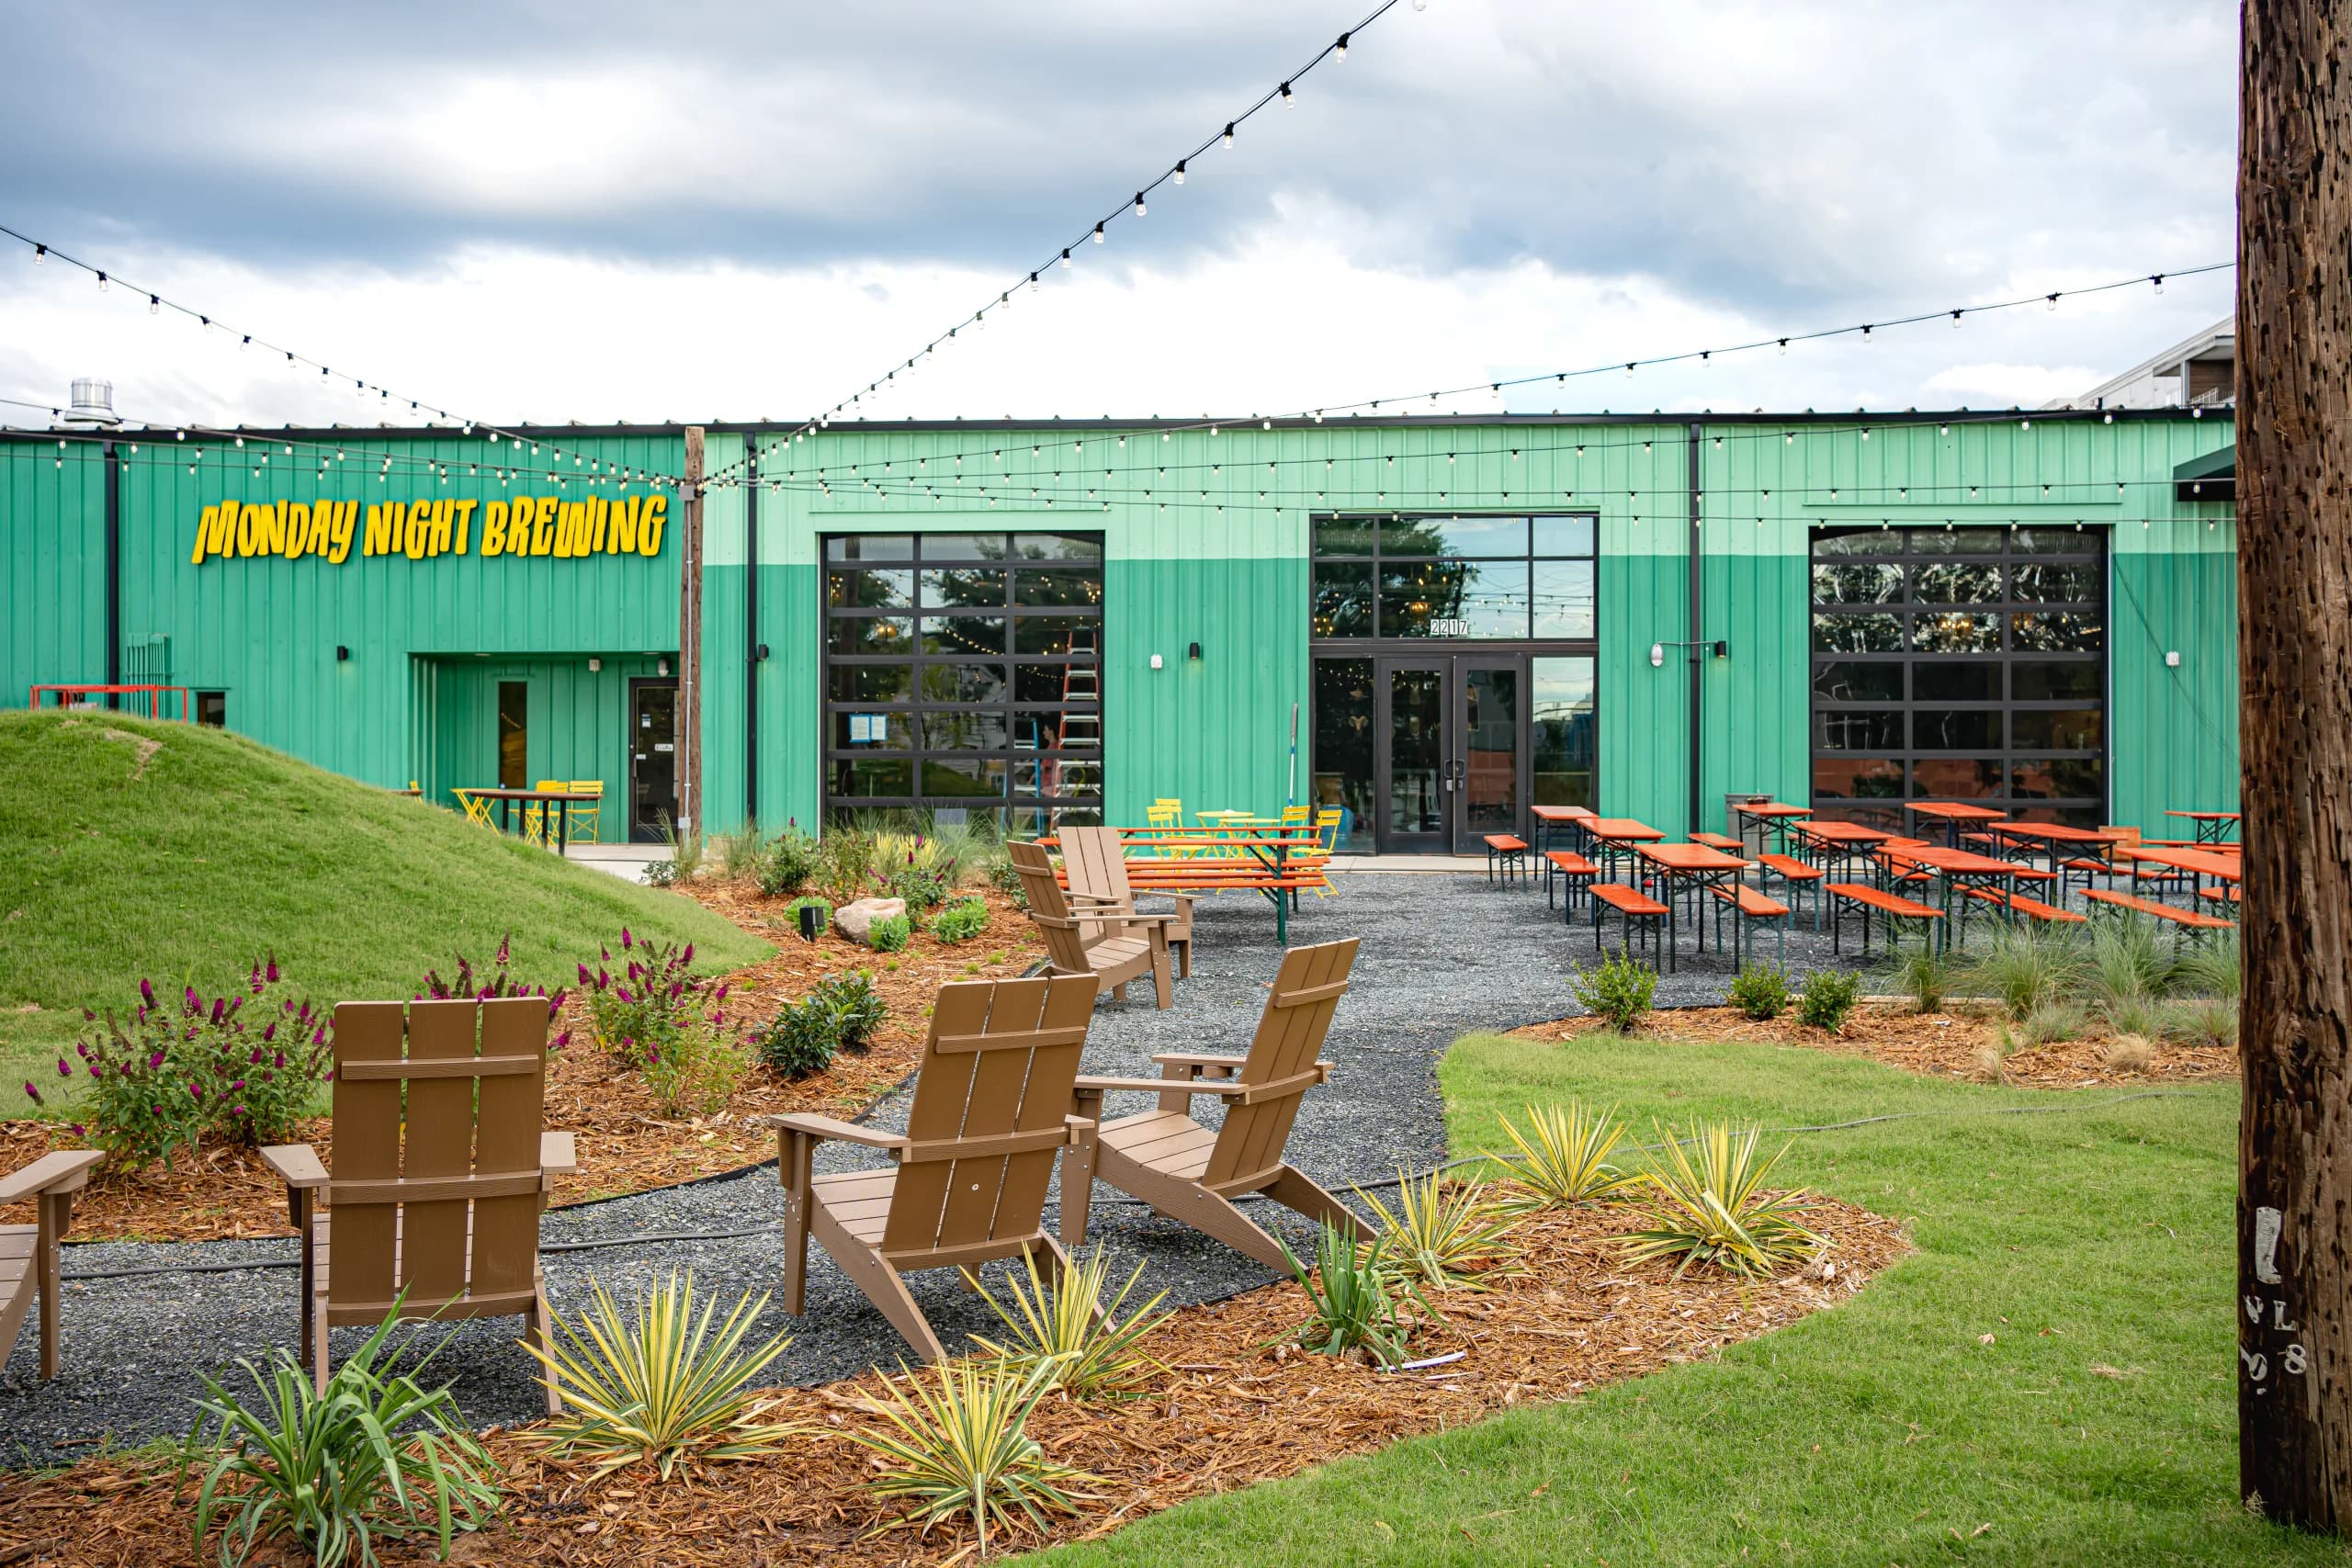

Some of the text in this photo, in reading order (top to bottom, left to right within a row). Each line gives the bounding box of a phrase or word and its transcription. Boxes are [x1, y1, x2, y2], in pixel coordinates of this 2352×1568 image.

[191, 494, 667, 565] MONDAY NIGHT BREWING
[1431, 620, 1467, 634] 2217
